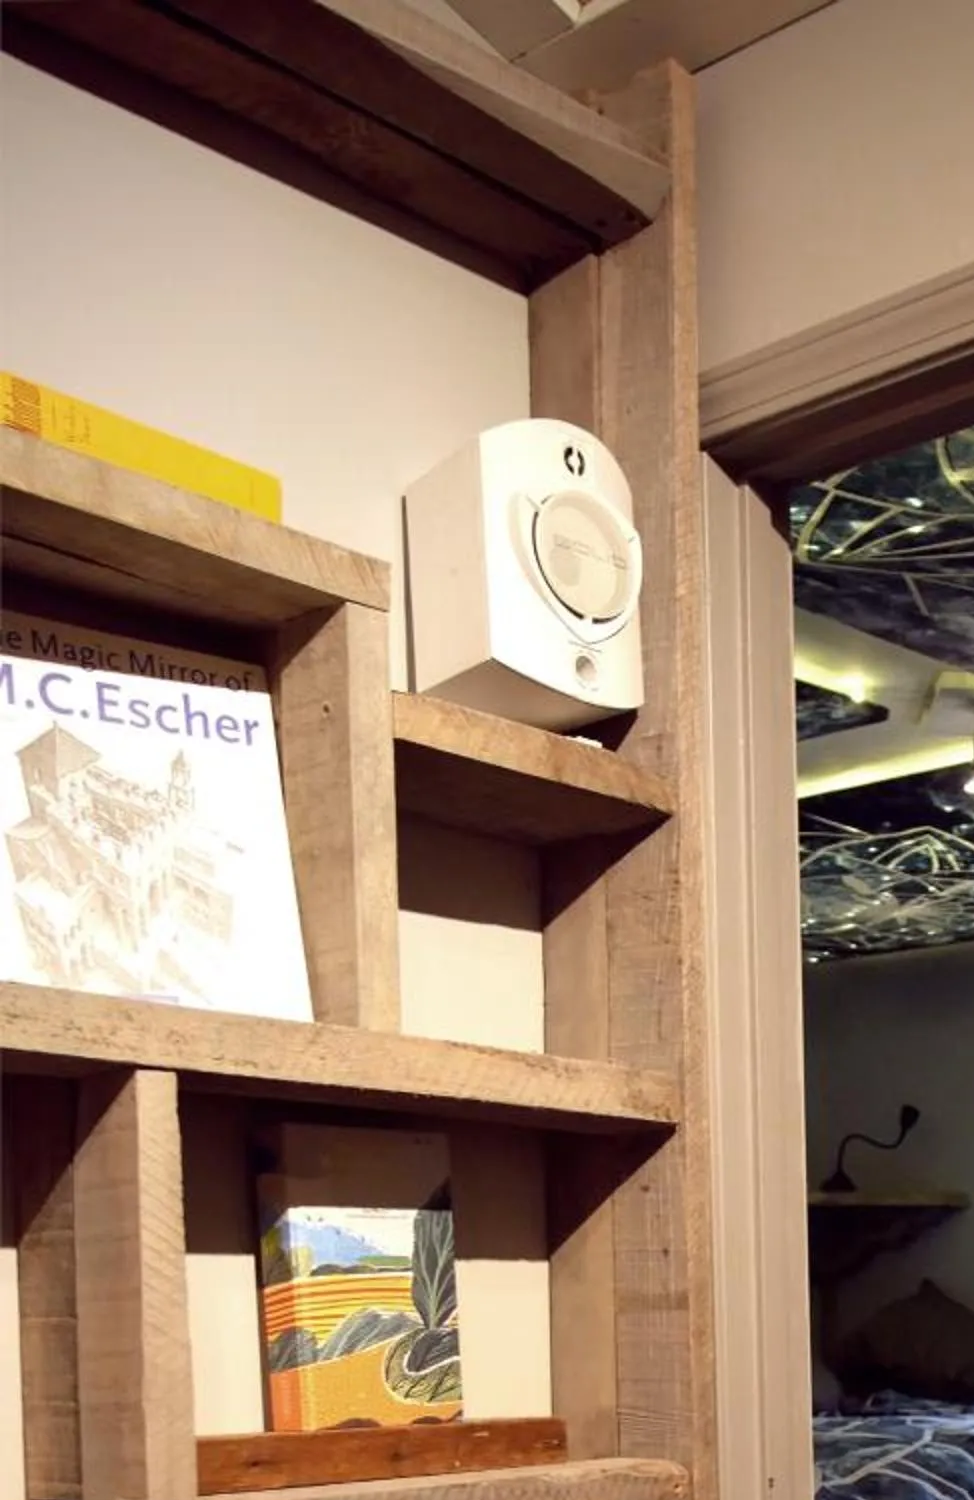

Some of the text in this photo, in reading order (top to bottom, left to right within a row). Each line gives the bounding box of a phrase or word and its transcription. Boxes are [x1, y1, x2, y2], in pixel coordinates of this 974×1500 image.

[32, 630, 121, 671] Magic
[130, 651, 216, 686] Mirror
[226, 673, 253, 691] of
